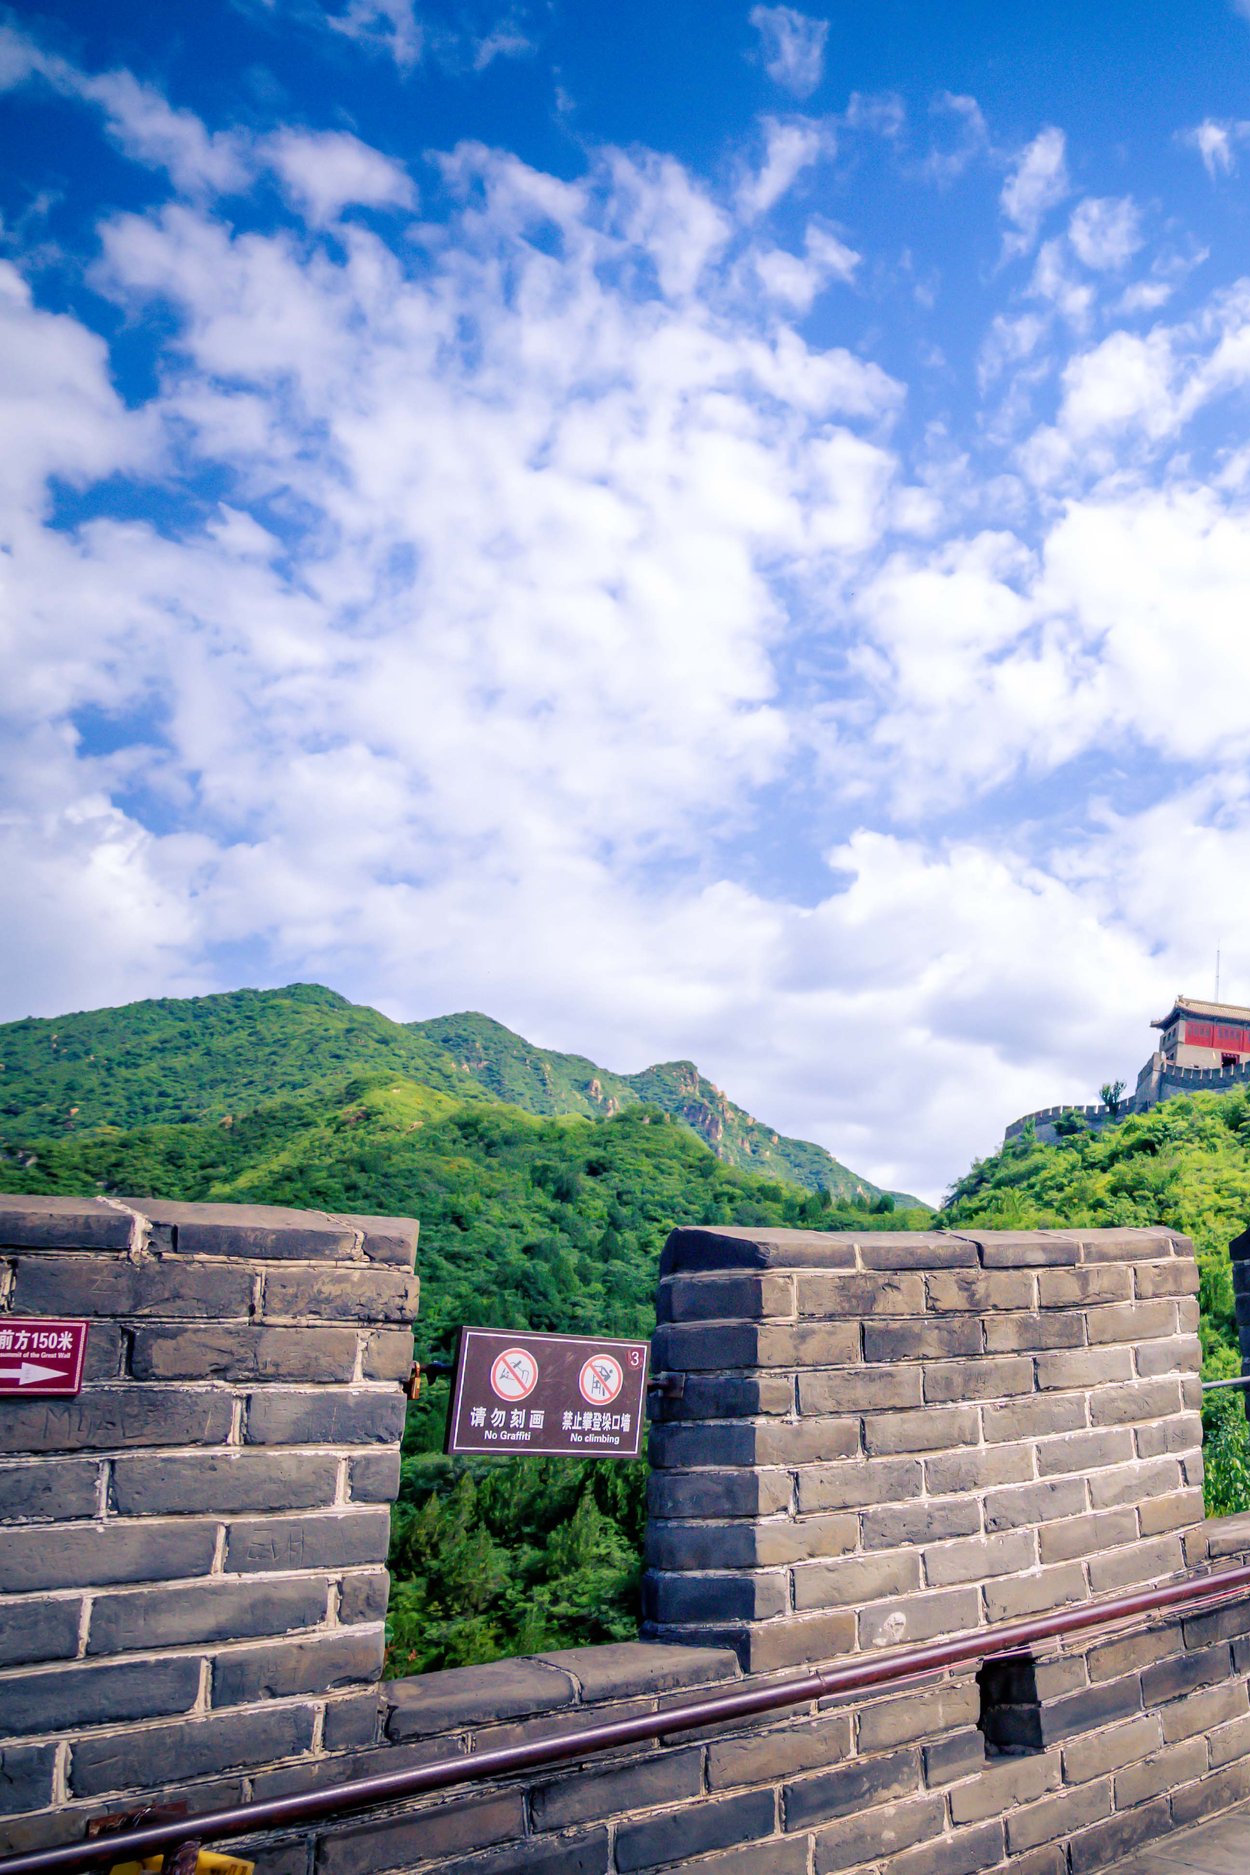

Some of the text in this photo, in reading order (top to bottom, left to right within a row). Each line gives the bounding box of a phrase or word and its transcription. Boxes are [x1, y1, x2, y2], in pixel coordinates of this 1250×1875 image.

[0, 1329, 73, 1350] 前方150米
[630, 1351, 639, 1366] 3
[470, 1407, 545, 1429] 请勿刻画
[562, 1411, 631, 1432] 禁止攀登垛口墙
[484, 1430, 532, 1441] No Graffiti
[570, 1433, 620, 1445] No climbing
